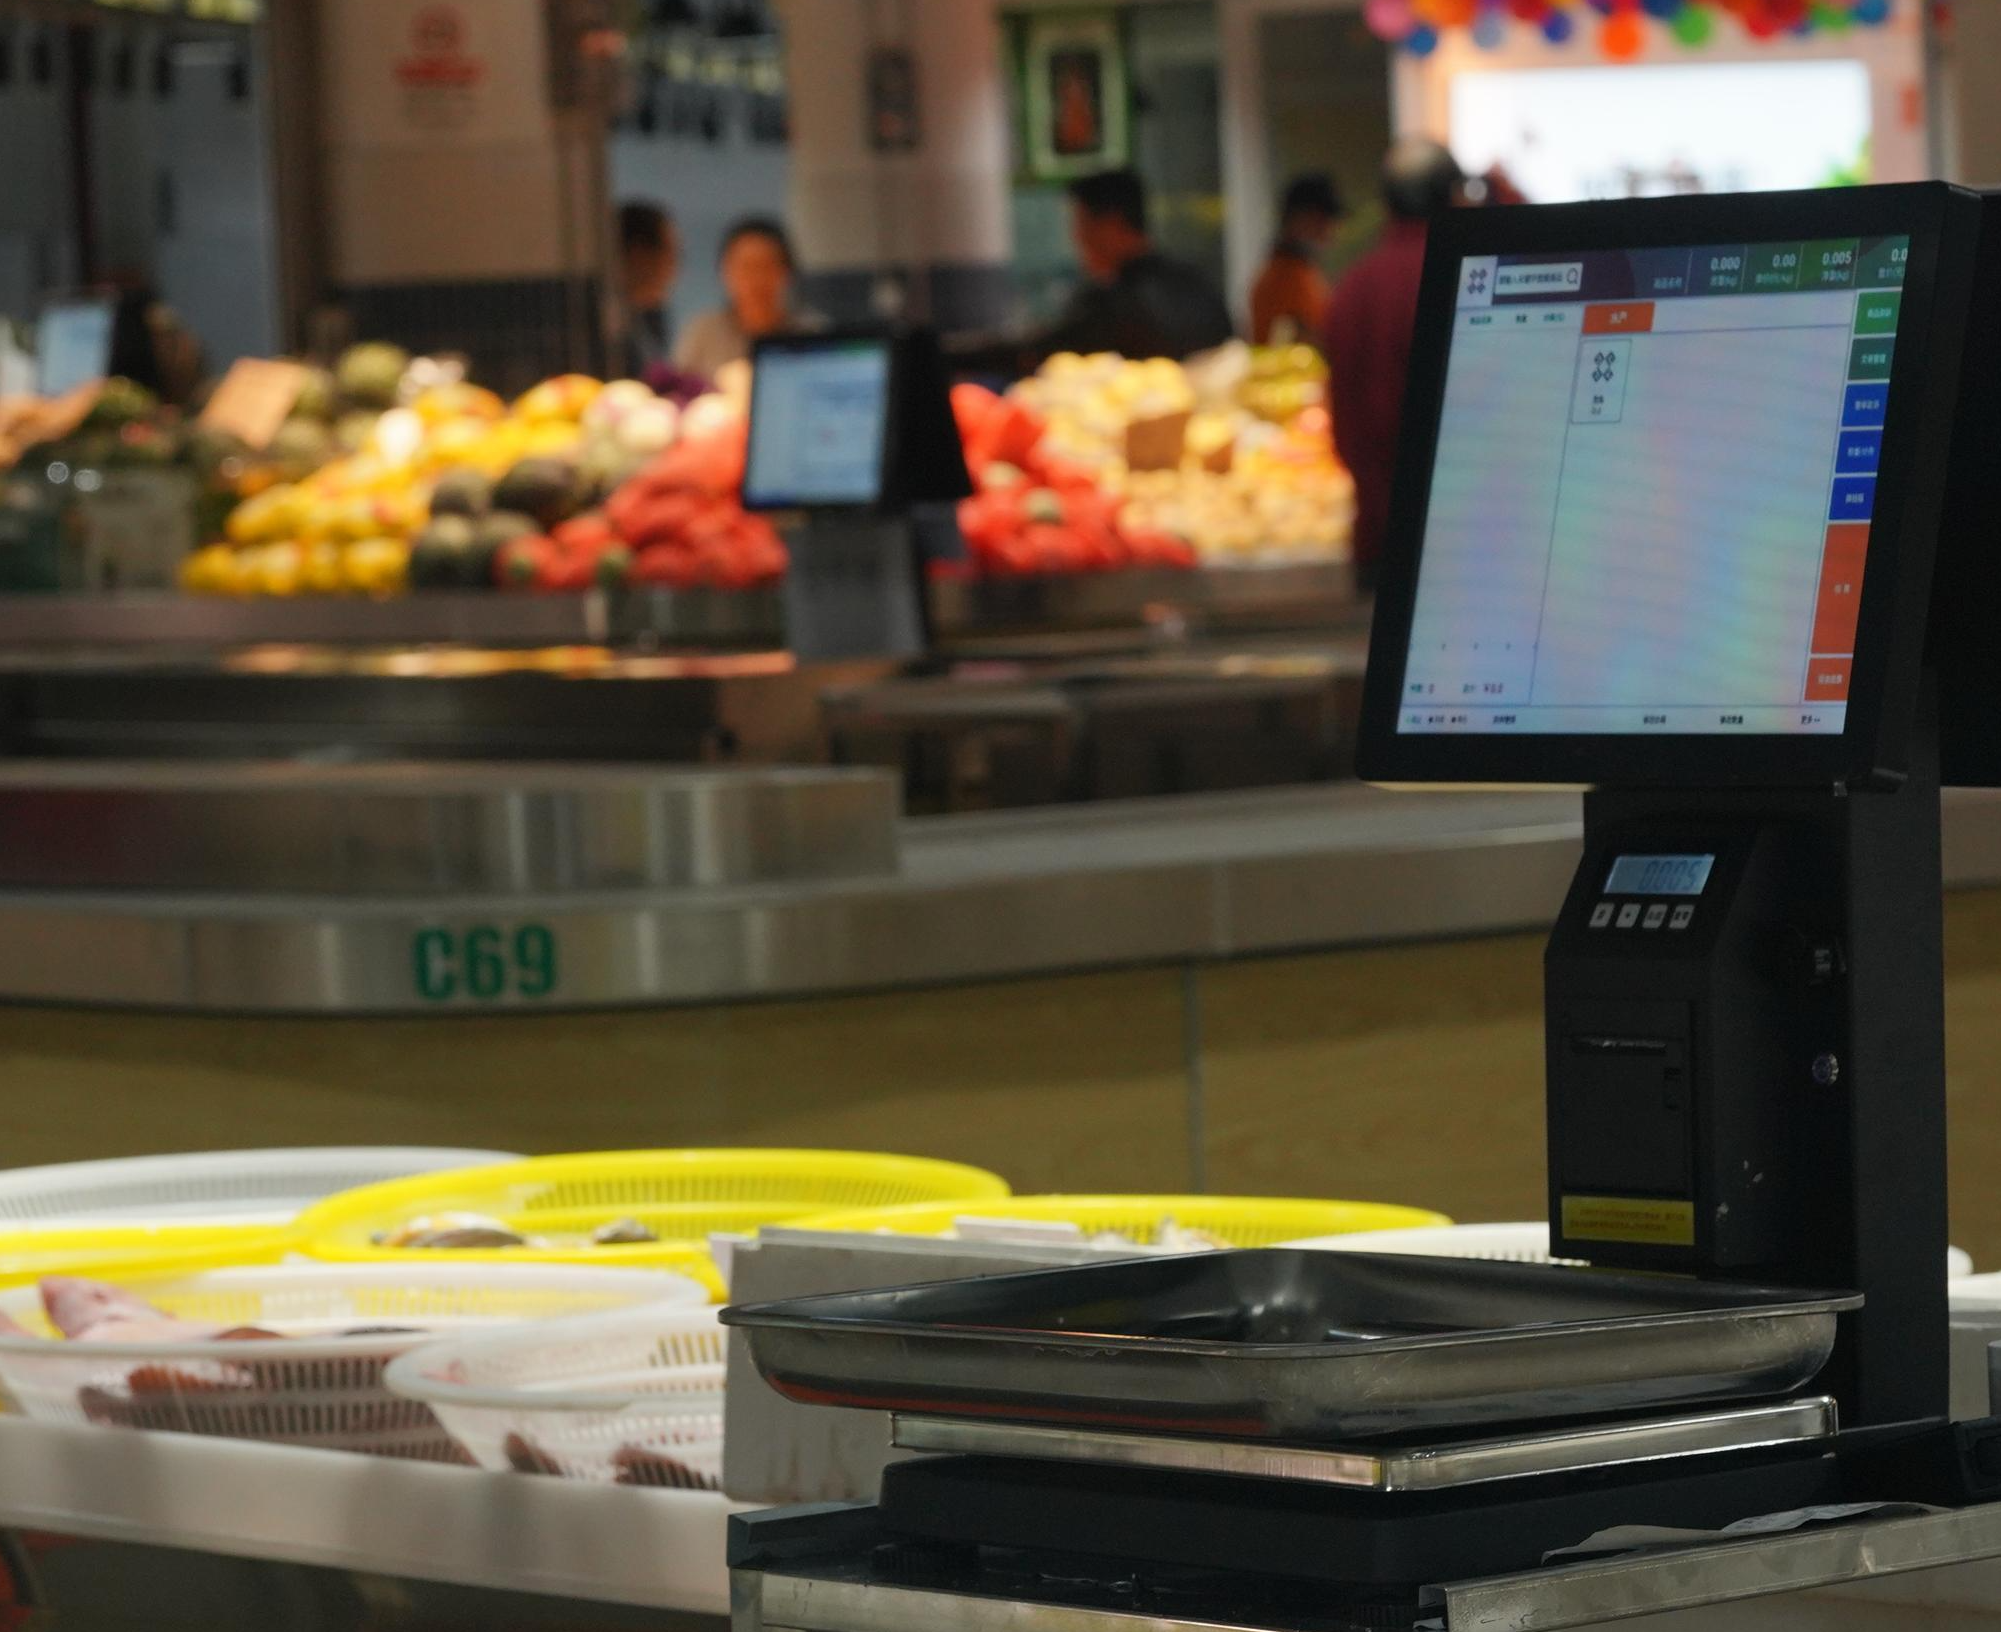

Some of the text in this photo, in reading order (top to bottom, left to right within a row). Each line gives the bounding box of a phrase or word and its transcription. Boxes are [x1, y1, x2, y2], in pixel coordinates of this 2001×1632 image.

[1711, 256, 1740, 271] 0.000
[1772, 253, 1796, 268] 0.00
[1822, 251, 1851, 266] 0.005
[414, 924, 556, 998] C69
